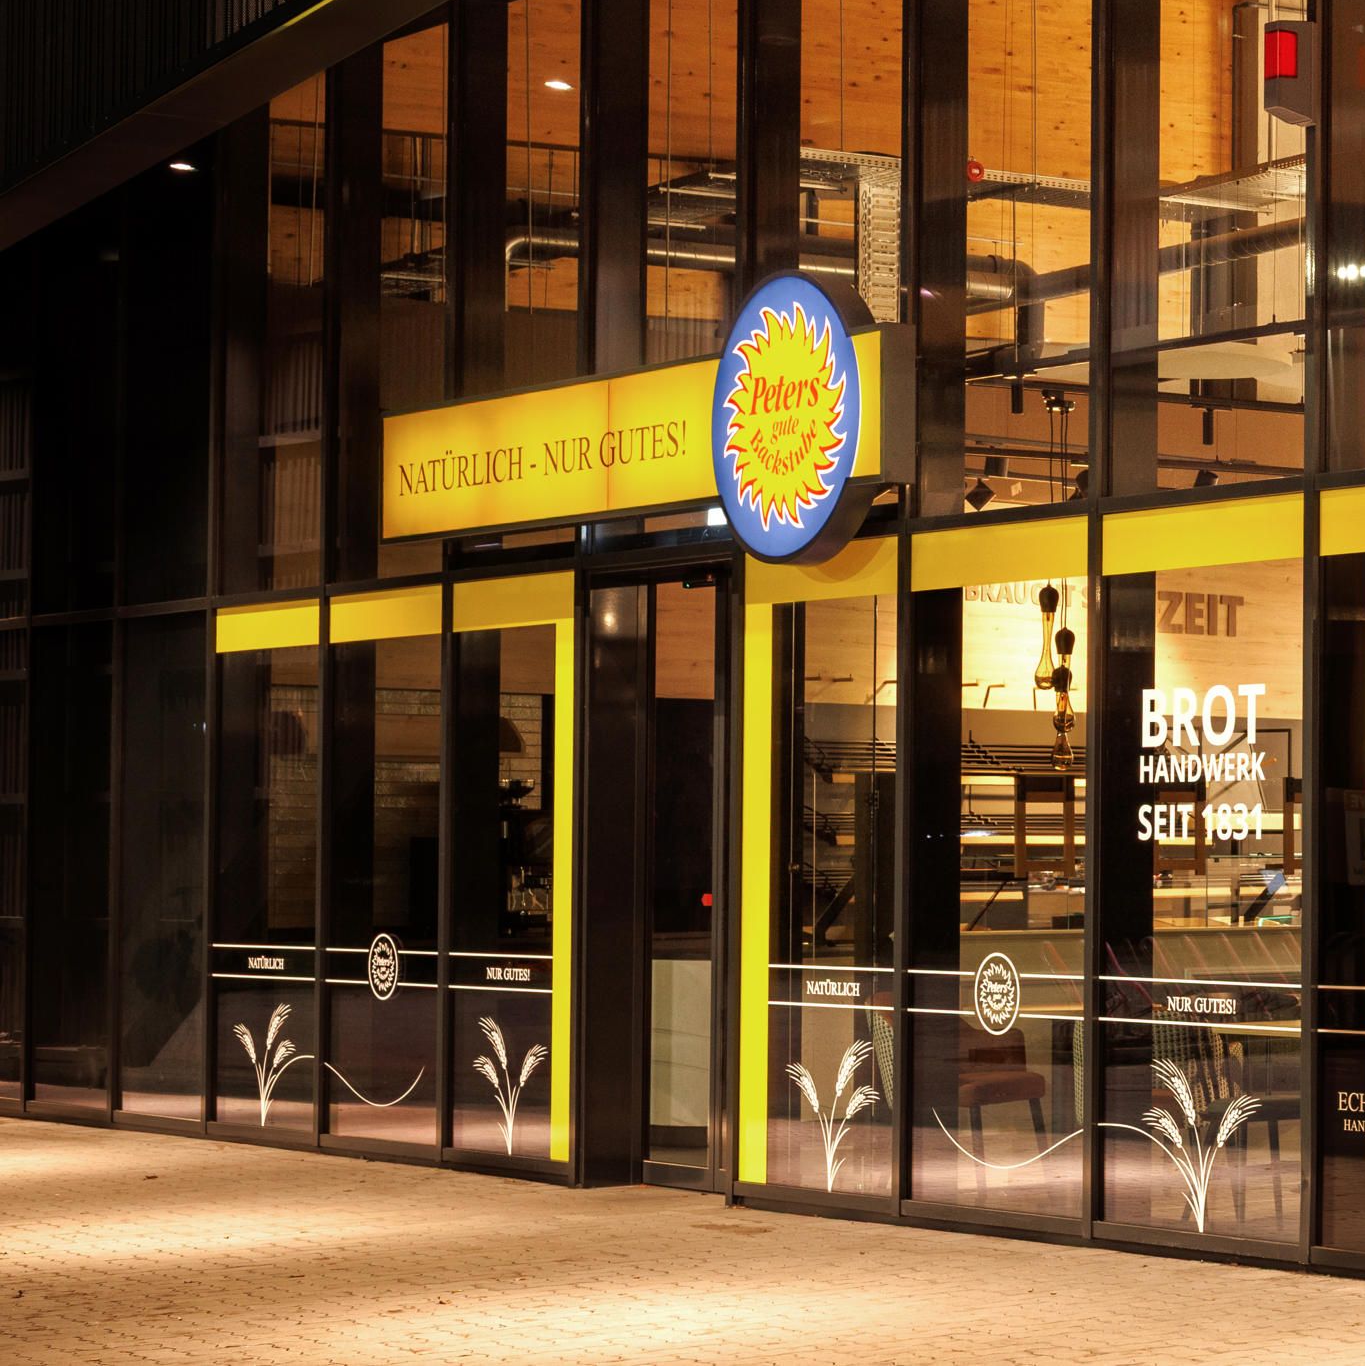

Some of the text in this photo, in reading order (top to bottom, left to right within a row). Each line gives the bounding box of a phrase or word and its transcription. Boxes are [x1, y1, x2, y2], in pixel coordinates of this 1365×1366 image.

[749, 376, 820, 416] Peters
[771, 414, 799, 444] gute
[399, 446, 524, 497] NATÜRLICH
[543, 437, 592, 477] NUR
[600, 420, 688, 468] GUTES!
[750, 418, 818, 476] Backstube
[965, 582, 1076, 608] BRAUCT
[1157, 591, 1244, 637] ZEIT
[1141, 683, 1266, 748] BROT
[1138, 752, 1266, 784] HANDWERK
[1137, 802, 1263, 841] SEIT 1831
[248, 956, 285, 970] NATÜRLICH
[486, 966, 531, 981] NUR GUTES!
[806, 979, 860, 997] NATÜRLICH
[1167, 995, 1237, 1015] NUR GUTES!
